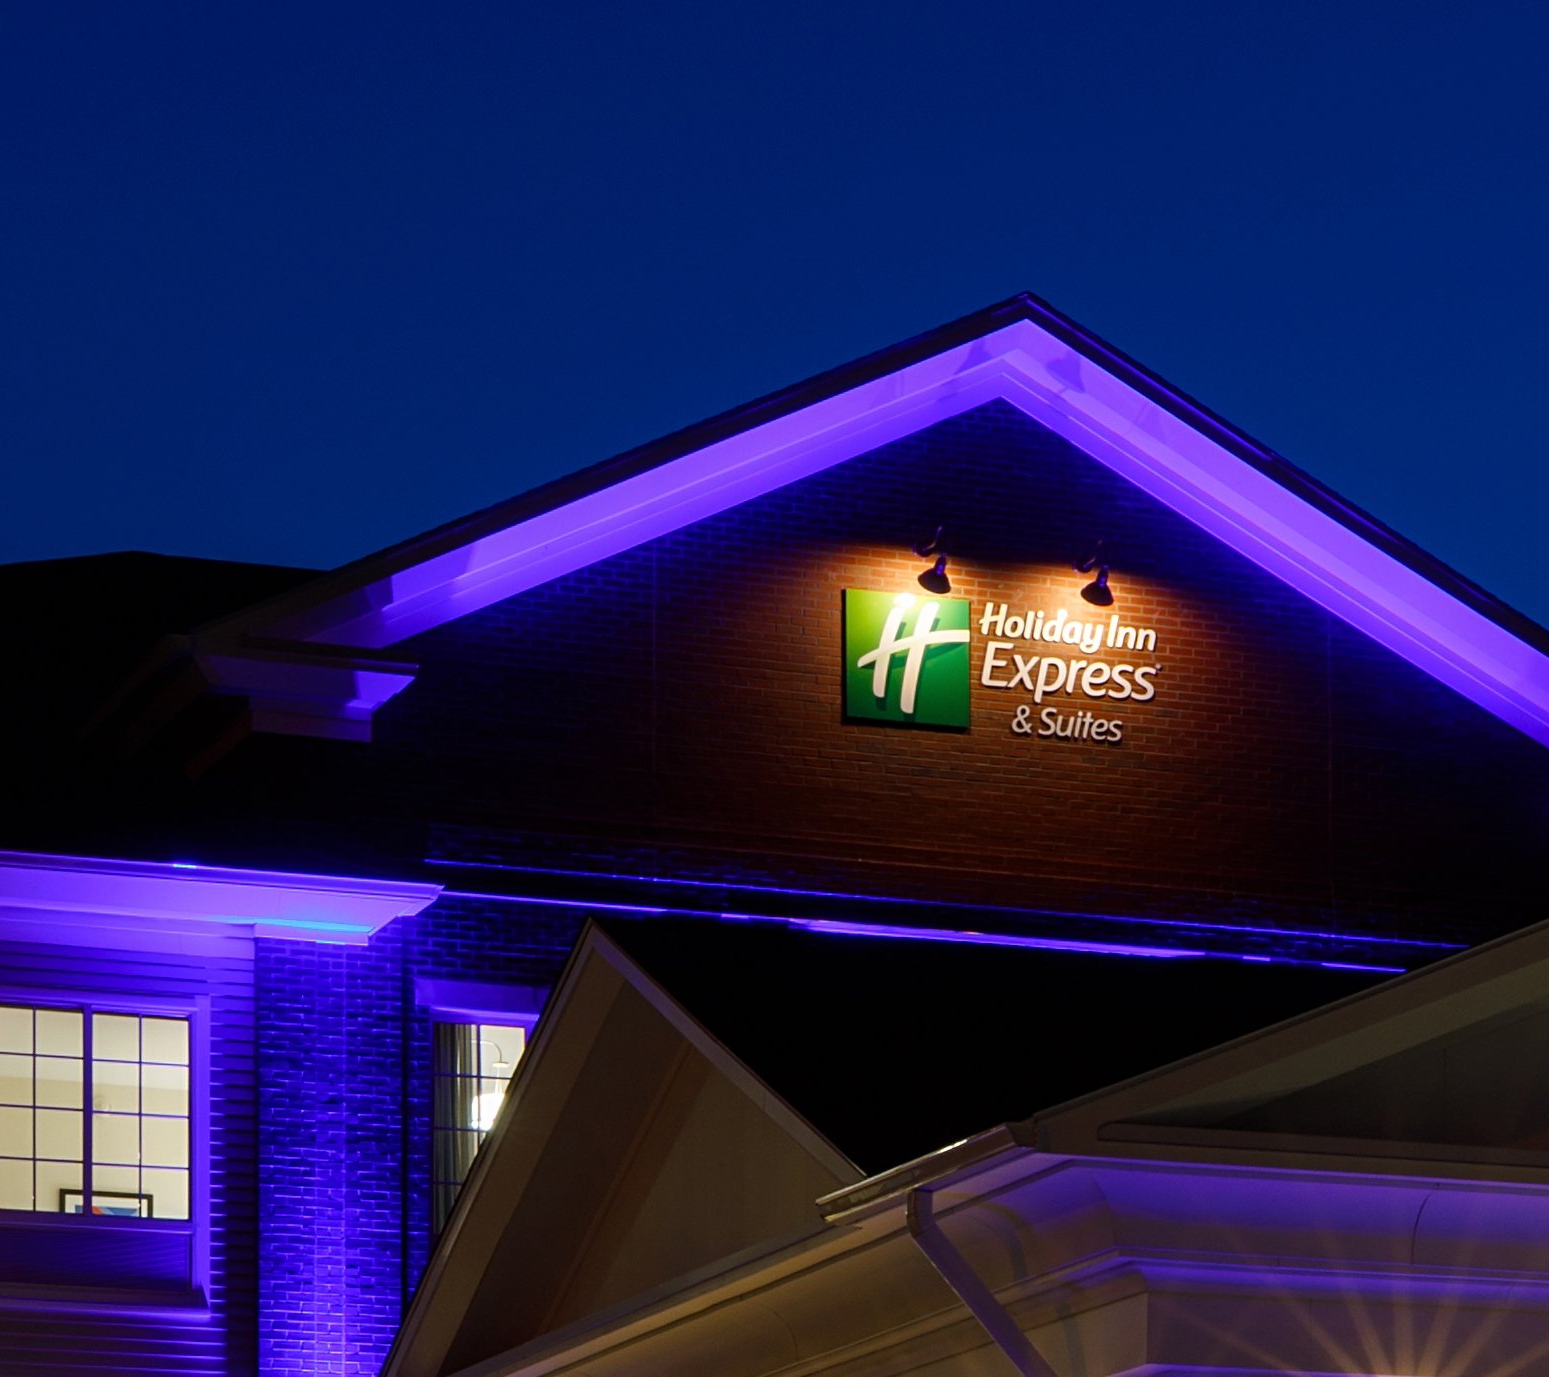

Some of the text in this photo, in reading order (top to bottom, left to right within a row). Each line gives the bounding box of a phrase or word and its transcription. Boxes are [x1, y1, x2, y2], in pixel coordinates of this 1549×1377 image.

[979, 602, 1157, 654] Holiday Inn
[857, 600, 970, 714] H
[981, 641, 1158, 703] Express
[1012, 705, 1123, 742] & Suites
